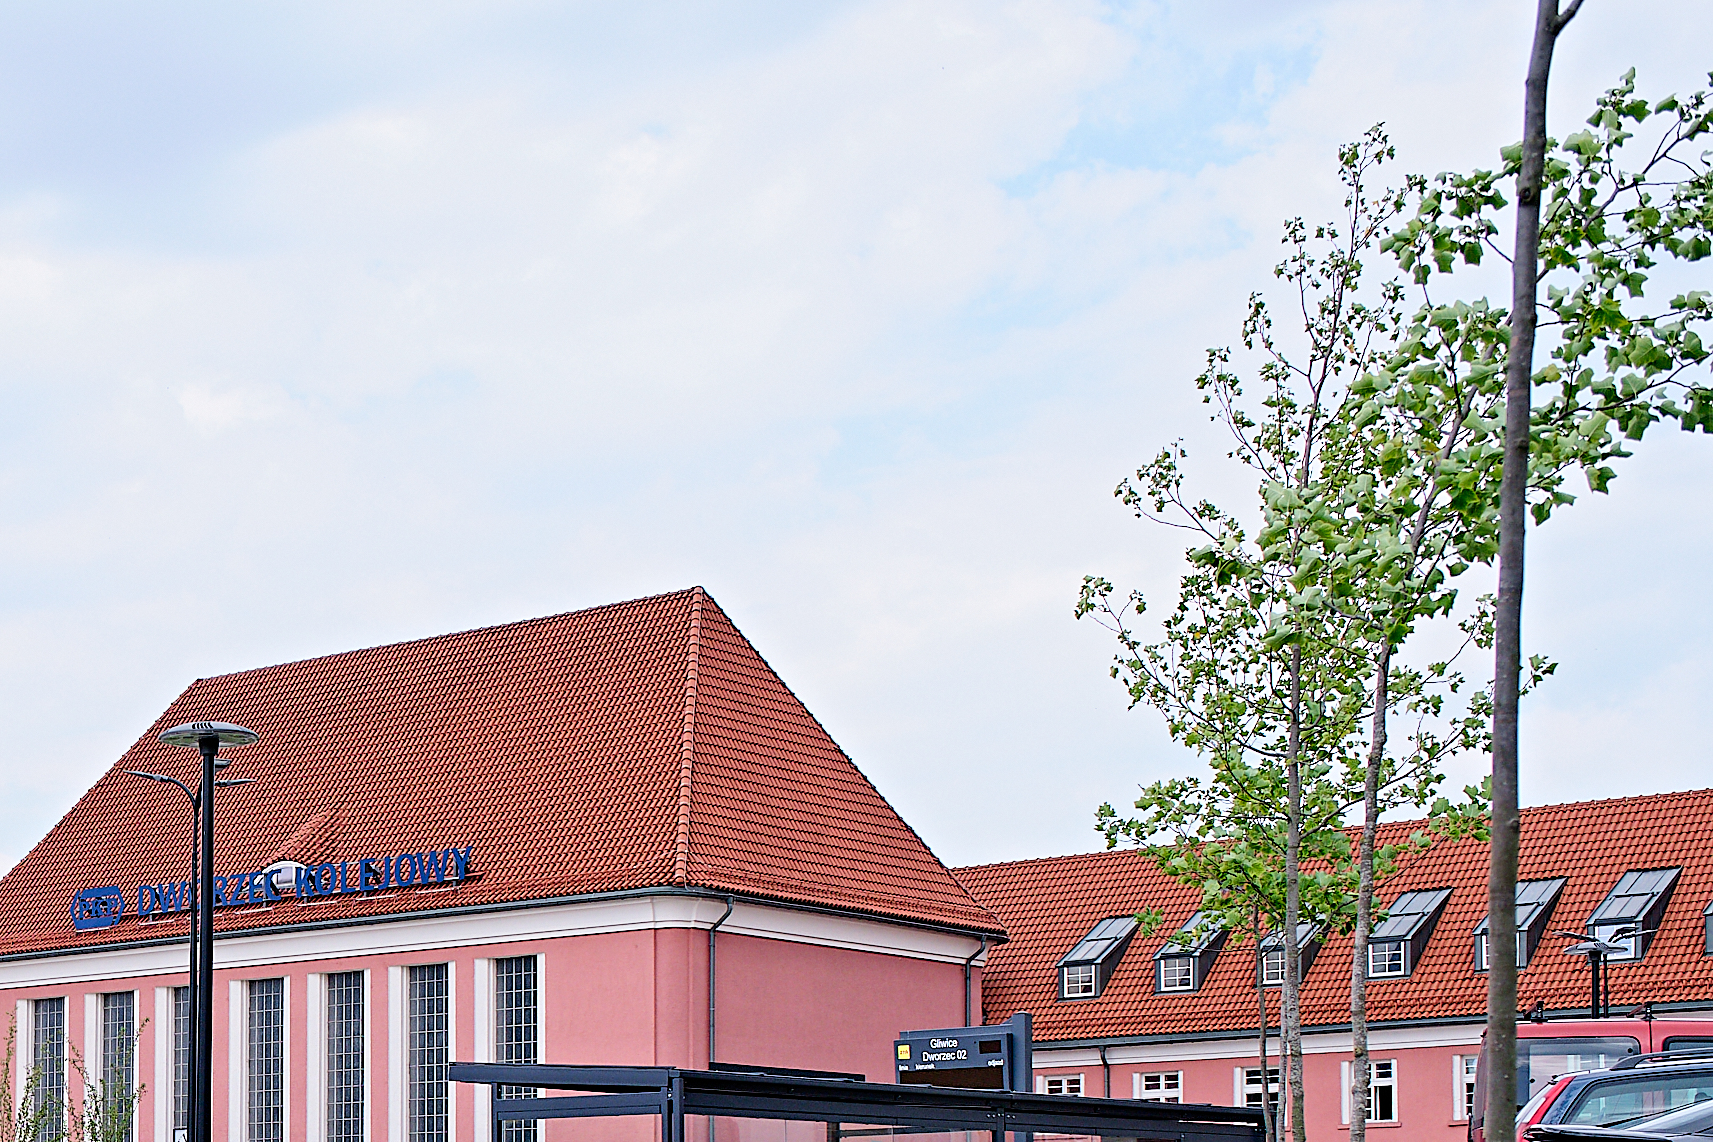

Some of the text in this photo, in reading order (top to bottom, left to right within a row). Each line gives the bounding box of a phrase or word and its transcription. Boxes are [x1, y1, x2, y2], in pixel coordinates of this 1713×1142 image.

[295, 846, 473, 898] KOLEJOWY
[78, 898, 118, 918] PKP
[930, 1038, 958, 1048] Gliwice
[922, 1050, 967, 1062] Dworzec 02
